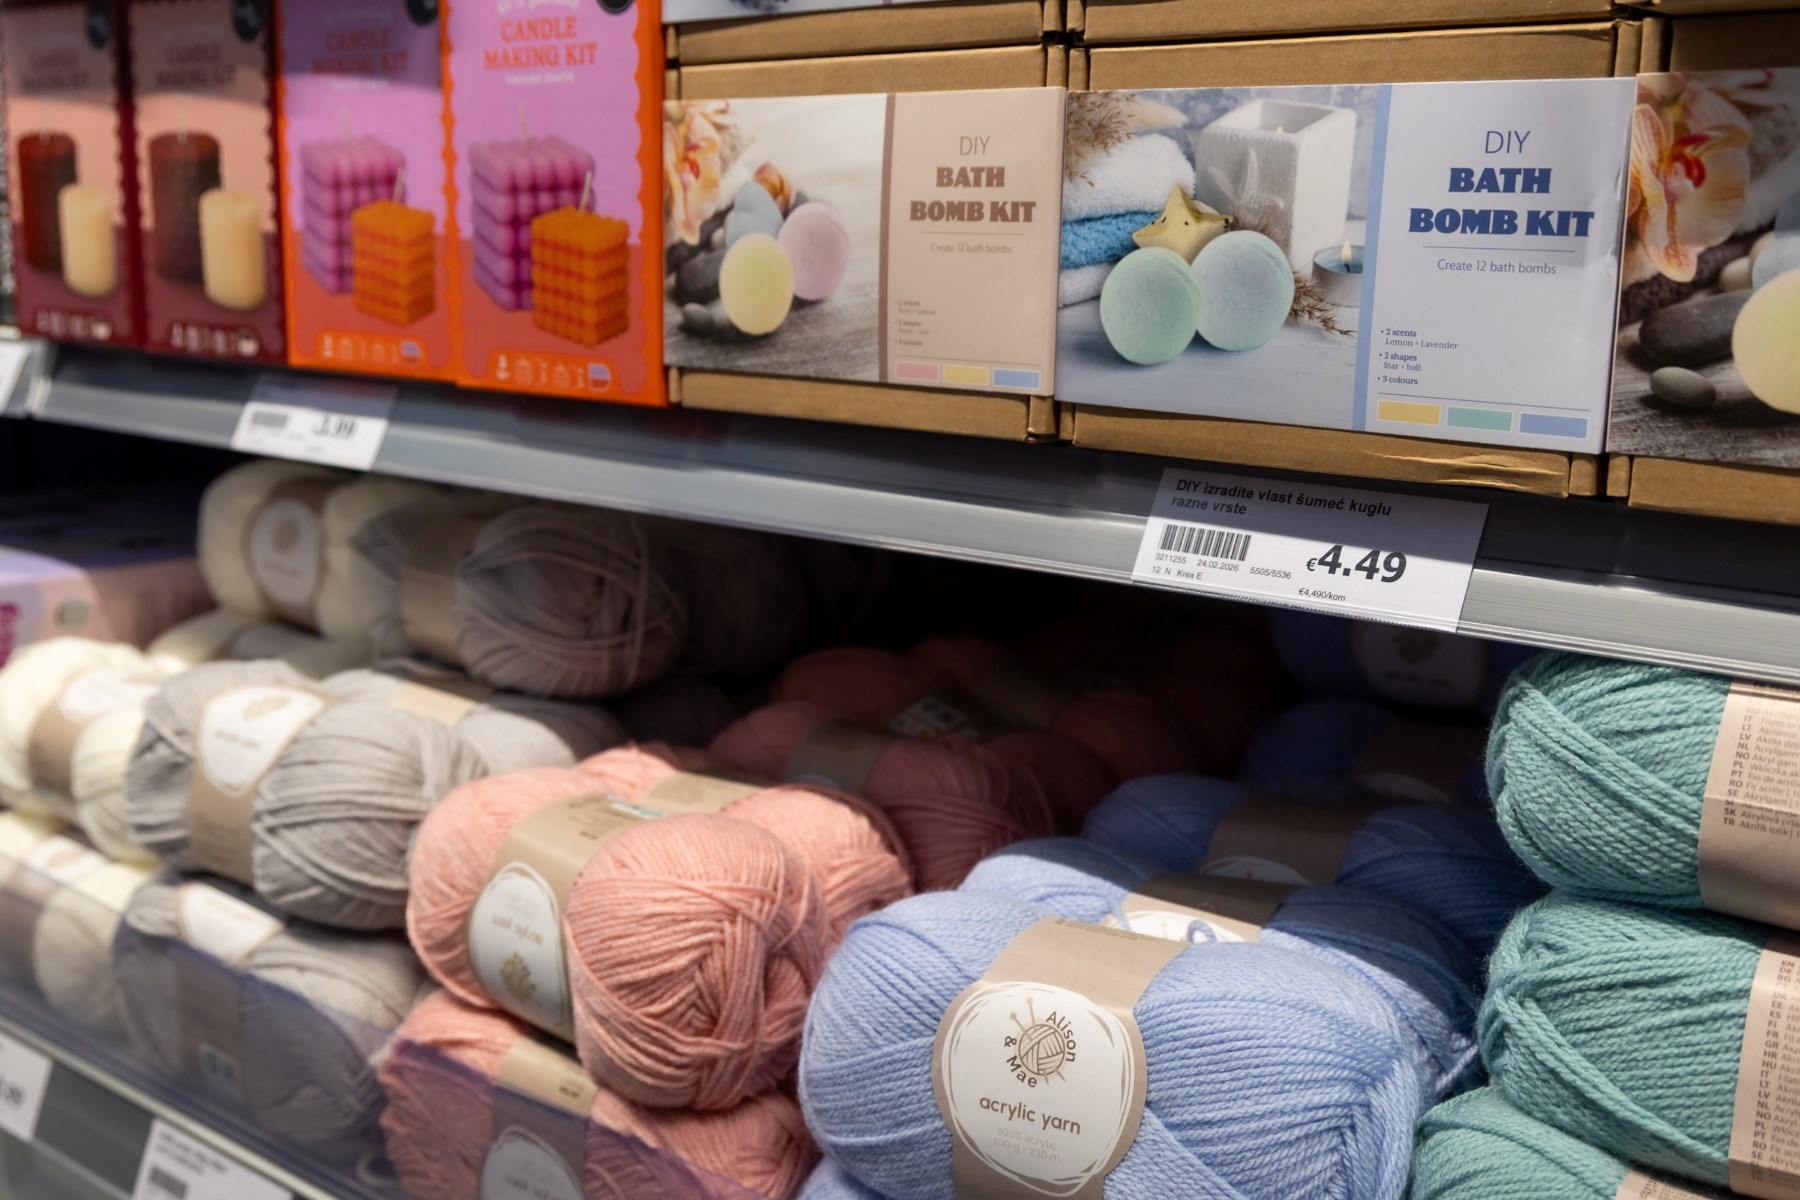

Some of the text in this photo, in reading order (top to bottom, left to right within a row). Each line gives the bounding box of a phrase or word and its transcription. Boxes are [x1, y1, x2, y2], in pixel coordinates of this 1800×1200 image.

[501, 16, 577, 42] CANDLE
[483, 42, 597, 69] MAKING KIT
[960, 135, 991, 155] DIY
[1485, 130, 1531, 154] DIY
[936, 166, 1005, 187] BATH
[1448, 167, 1552, 193] BATH
[910, 200, 1036, 223] BOMB KIT
[1408, 208, 1595, 237] BOMB KIT
[1437, 258, 1557, 275] Create 12 bath bombs
[1386, 328, 1391, 336] 2
[1385, 338, 1413, 347] Lemon
[1420, 340, 1459, 350] Lavender
[1384, 352, 1417, 362] 2 shapes
[1383, 361, 1399, 370] Star
[1406, 363, 1421, 371] ball
[1382, 375, 1418, 385] 3 colours
[1176, 479, 1392, 517] DIY izradite vlast šumeć kuglu
[1171, 497, 1247, 515] razne vrste
[1154, 552, 1292, 580] 3211255 24.02.2026 5505/5536
[1306, 544, 1407, 583] €4.49
[1152, 566, 1161, 574] 12
[1176, 570, 1195, 578] Krea
[1196, 572, 1203, 580] E
[1741, 724, 1752, 732] LT
[1739, 733, 1751, 741] LV
[1737, 742, 1749, 751] NL
[1735, 751, 1750, 761] NO
[1732, 760, 1744, 769] PL
[1731, 769, 1744, 779] PT
[1729, 779, 1744, 788] RO
[1726, 788, 1739, 798] SE
[1723, 807, 1736, 817] SK
[1722, 816, 1736, 826] TR
[1781, 960, 1795, 968] EN
[1769, 1010, 1781, 1019] ES
[1768, 1020, 1777, 1029] FI
[1046, 1011, 1076, 1062] Alison
[1766, 1029, 1779, 1039] FR
[1764, 1040, 1779, 1049] GR
[1763, 1049, 1777, 1060] HR
[1004, 1036, 1037, 1088] & Mae
[1762, 1059, 1777, 1070] HU
[1760, 1069, 1770, 1079] IT
[1760, 1079, 1770, 1089] LT
[1758, 1089, 1770, 1099] LV
[1757, 1099, 1770, 1110] NL
[979, 1097, 1081, 1135] acrylic yarn
[1756, 1110, 1771, 1120] NO
[1754, 1120, 1766, 1130] PL
[1753, 1130, 1767, 1140] PT
[1025, 1135, 1057, 1151] acrylic
[1752, 1140, 1767, 1151] RO
